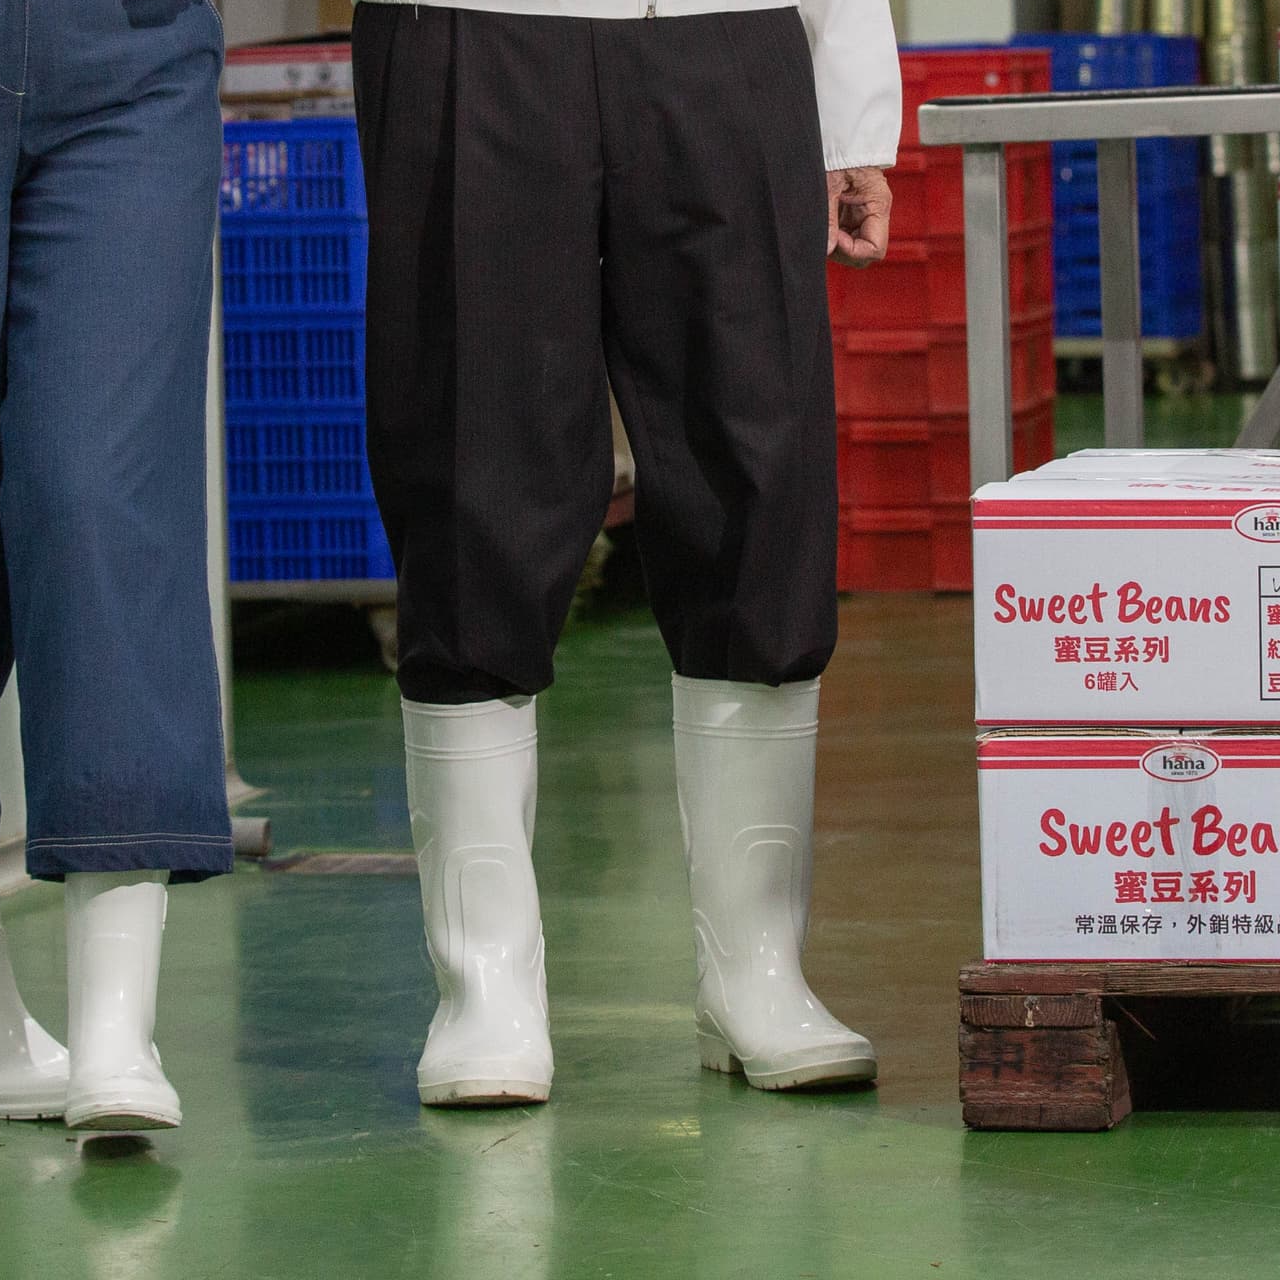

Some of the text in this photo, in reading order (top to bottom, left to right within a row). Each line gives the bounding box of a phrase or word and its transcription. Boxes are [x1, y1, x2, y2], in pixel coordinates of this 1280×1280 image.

[994, 582, 1230, 624] Sweet Beans
[1055, 636, 1169, 662] 蜜豆系列
[1085, 672, 1137, 691] 6罐入
[1162, 755, 1206, 769] hana
[1040, 807, 1178, 857] Sweet
[1115, 870, 1256, 903] 蜜豆系列
